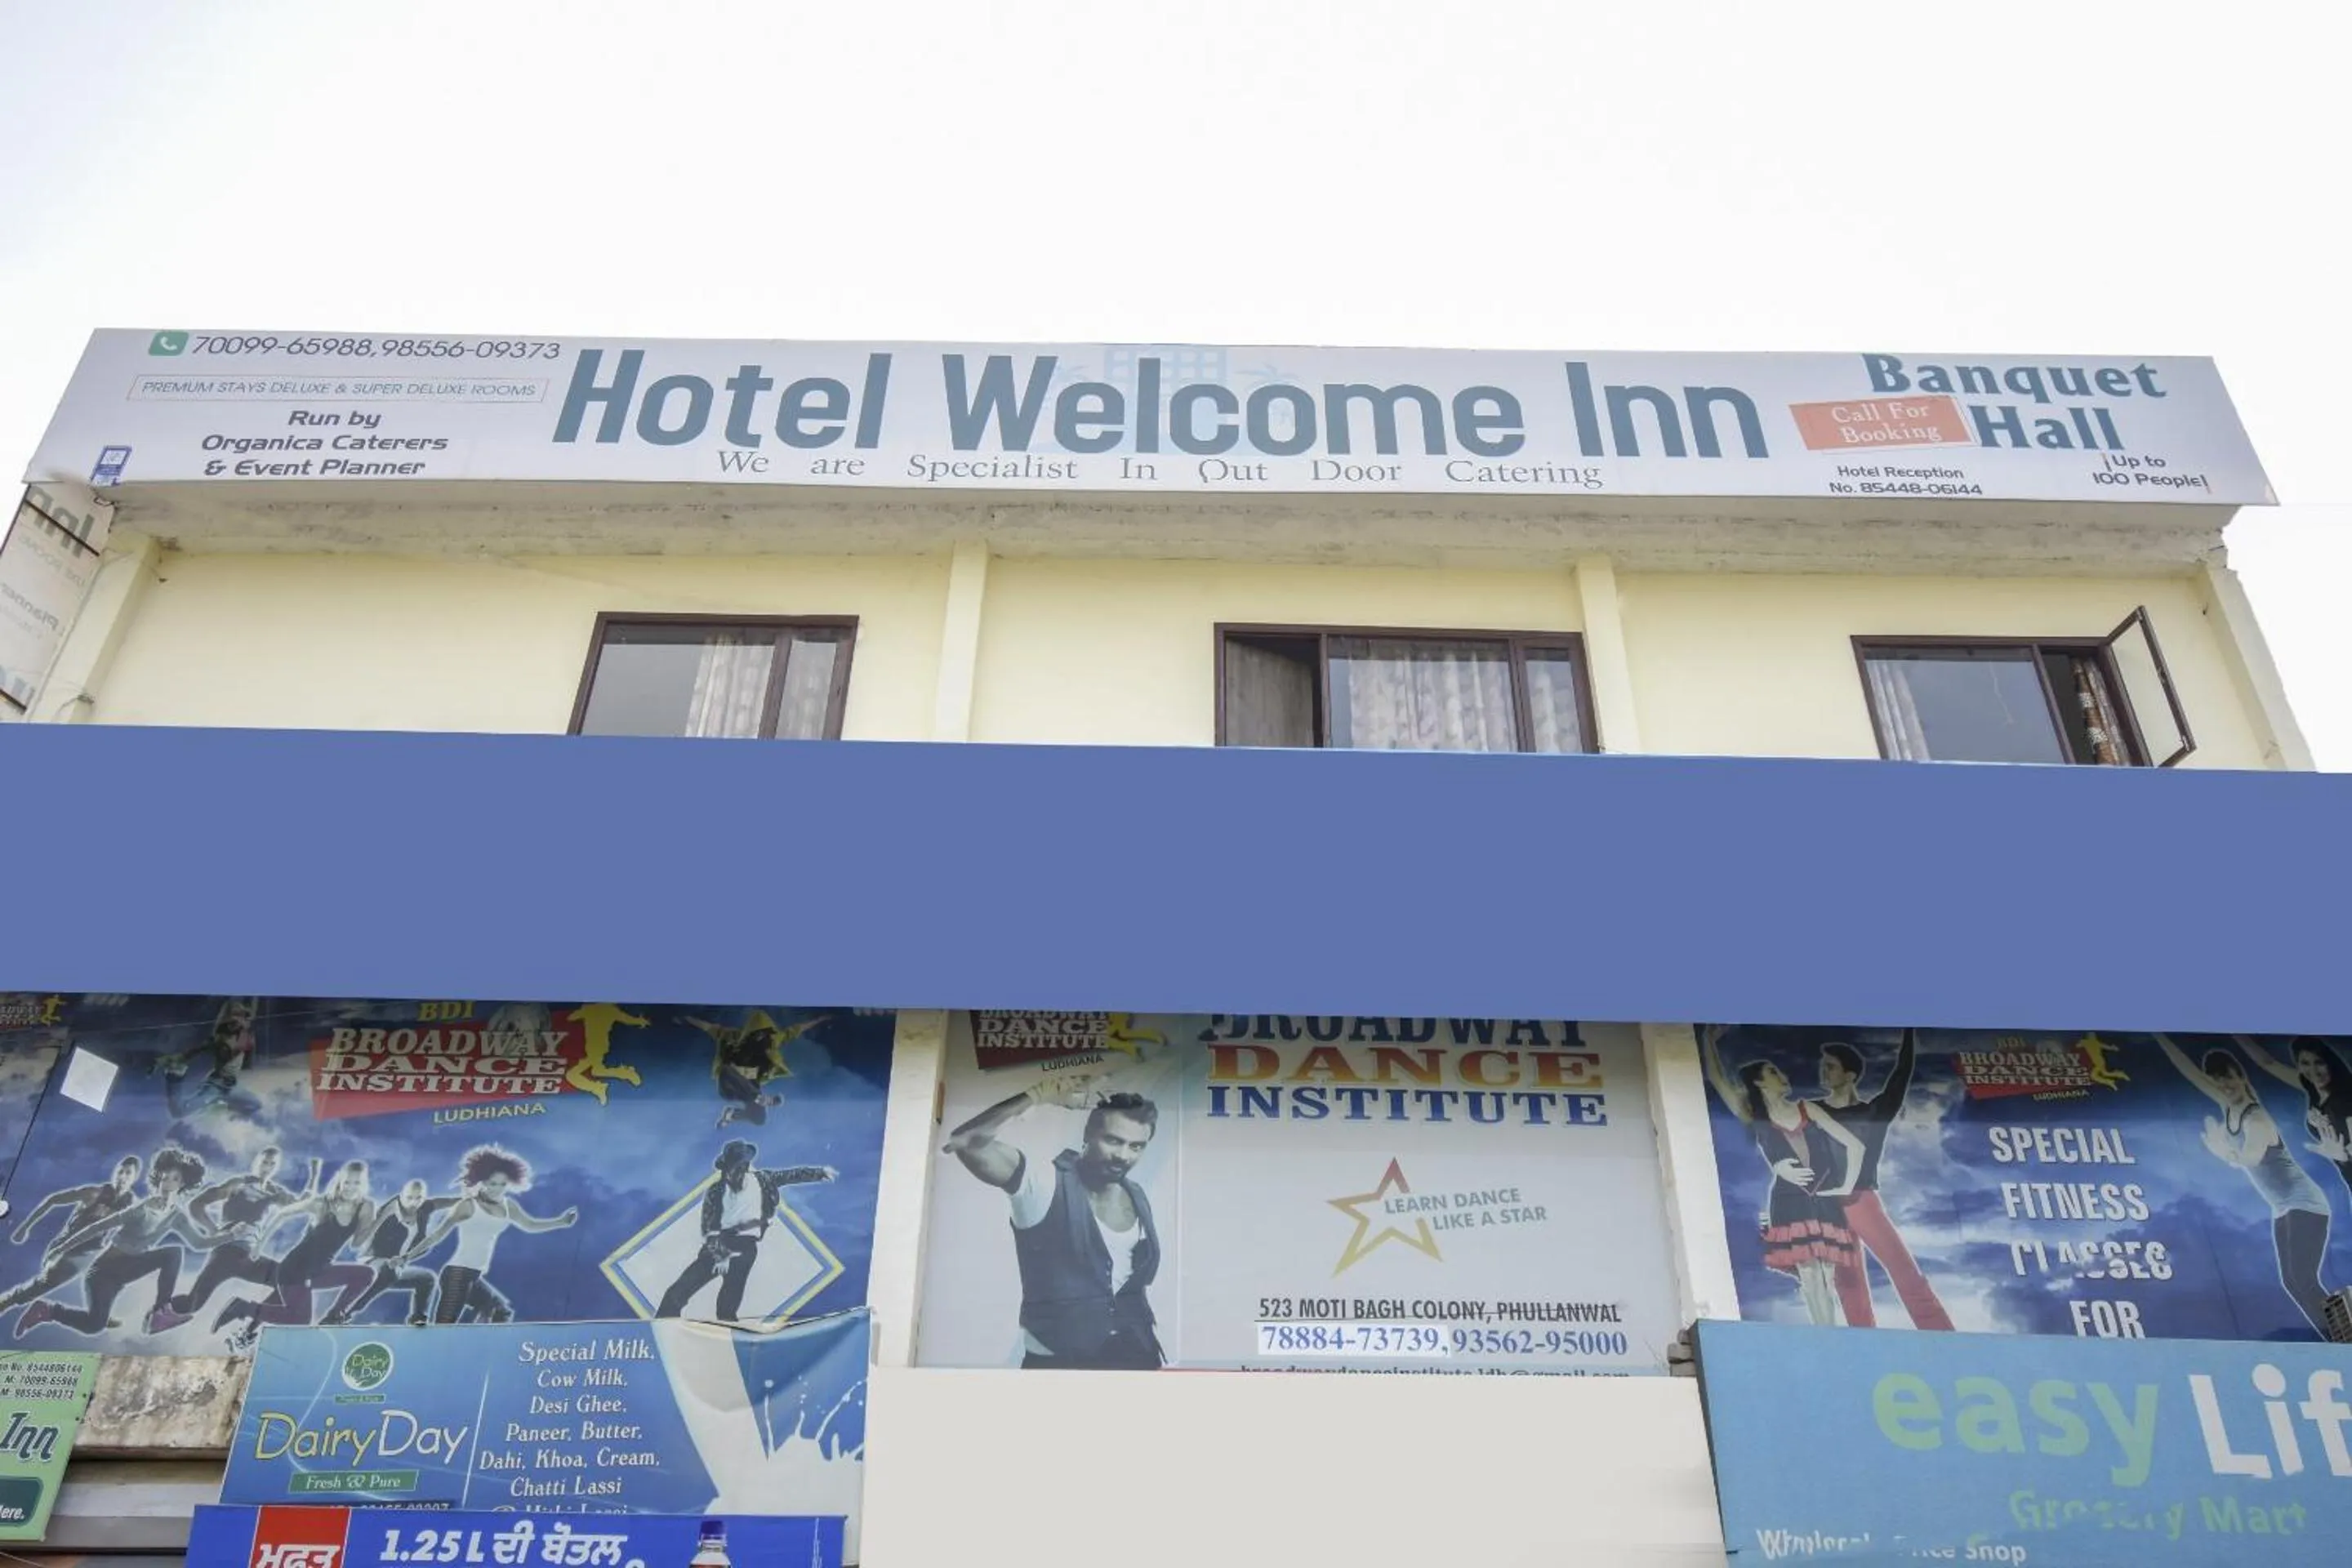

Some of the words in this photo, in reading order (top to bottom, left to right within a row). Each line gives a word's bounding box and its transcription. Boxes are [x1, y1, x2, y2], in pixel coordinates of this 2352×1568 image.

[192, 336, 560, 359] 70099-65988,98556-09373
[217, 381, 268, 393] STAYS
[269, 381, 331, 394] DELUXE
[335, 383, 347, 394] &
[352, 383, 402, 394] SUPER
[408, 383, 466, 395] DELUXE
[470, 383, 536, 396] ROOMS
[1862, 353, 2167, 403] Banquet
[552, 348, 893, 450] Hotel
[942, 354, 1526, 457] Welcome
[1565, 361, 1770, 459] Inn
[1831, 403, 1880, 423] Call
[1887, 402, 1930, 420] For
[287, 410, 341, 425] Run
[348, 410, 381, 429] by
[1967, 405, 2127, 452] Hall
[202, 434, 323, 453] Organica
[332, 434, 448, 450] Caterers
[1840, 423, 1943, 443] Booking
[204, 460, 226, 475] &
[234, 459, 313, 475] Event
[319, 459, 425, 475] Planner
[718, 449, 769, 474] We
[810, 457, 866, 476] are
[906, 452, 1079, 482] Specialist
[1119, 457, 1156, 480] In
[1198, 458, 1268, 483] Out
[1311, 458, 1403, 483] Door
[1445, 460, 1605, 490] Catering
[1837, 466, 1880, 478] Hotel
[1883, 466, 1965, 480] Reception
[2111, 454, 2140, 470] Up
[2145, 455, 2167, 468] to
[1829, 482, 1857, 493] No.
[417, 1000, 475, 1021] BDI
[979, 1018, 1107, 1034] DANCE
[326, 1027, 569, 1056] BROADWAY
[977, 1032, 1109, 1049] INSTITUTE
[326, 1053, 568, 1075] DANCE
[1207, 1044, 1604, 1089] DANCE
[1959, 1051, 2081, 1067] BROADWAY
[316, 1073, 564, 1094] INSTITUTE
[433, 1102, 546, 1125] LUDHIANA
[1207, 1085, 1607, 1127] INSTITUTE
[1989, 1127, 2136, 1165] SPECIAL
[1384, 1193, 1448, 1214] LEARN
[1454, 1187, 1521, 1209] DANCE
[2001, 1182, 2150, 1221] FITNESS
[1432, 1213, 1475, 1231] LIKE
[1481, 1210, 1495, 1227] A
[1499, 1206, 1547, 1224] STAR
[1259, 1298, 1293, 1319] 523
[1298, 1298, 1347, 1320] MOTI
[1353, 1298, 1406, 1320] BAGH
[1412, 1299, 1492, 1324] COLONY,
[1496, 1302, 1622, 1323] PHULLANWAL
[2069, 1299, 2146, 1339] FOR
[518, 1339, 597, 1365] Special
[537, 1369, 577, 1388] Cow
[529, 1396, 568, 1414] Desi
[0, 1412, 59, 1460] Inn
[1872, 1370, 2160, 1487] easy
[305, 1475, 341, 1490] Fresh
[369, 1475, 401, 1488] Pure
[510, 1475, 567, 1497] Chatti
[574, 1475, 623, 1495] Lassi
[379, 1528, 462, 1562] 1.25
